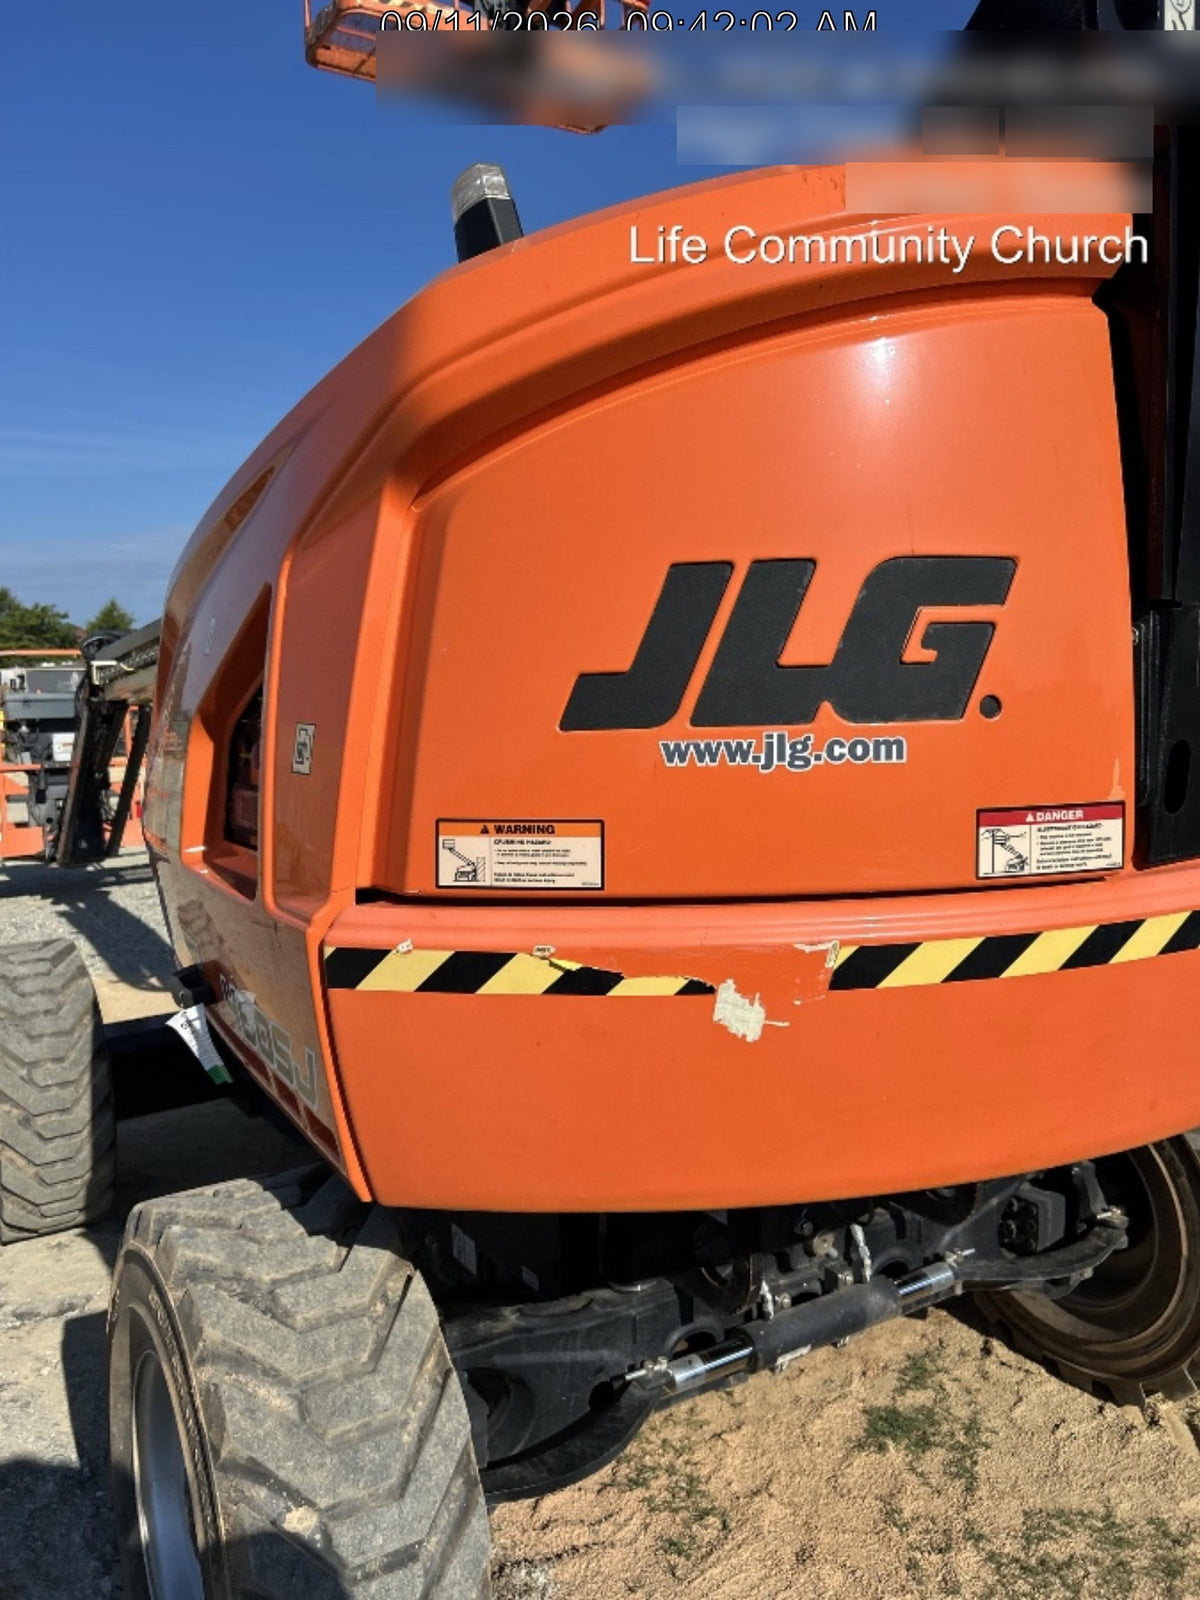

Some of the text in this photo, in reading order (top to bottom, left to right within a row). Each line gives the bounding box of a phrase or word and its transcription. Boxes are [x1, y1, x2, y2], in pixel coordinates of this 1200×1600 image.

[660, 732, 907, 772] www.jlg.com
[1036, 810, 1083, 822] DANGER
[494, 824, 555, 834] WARNING
